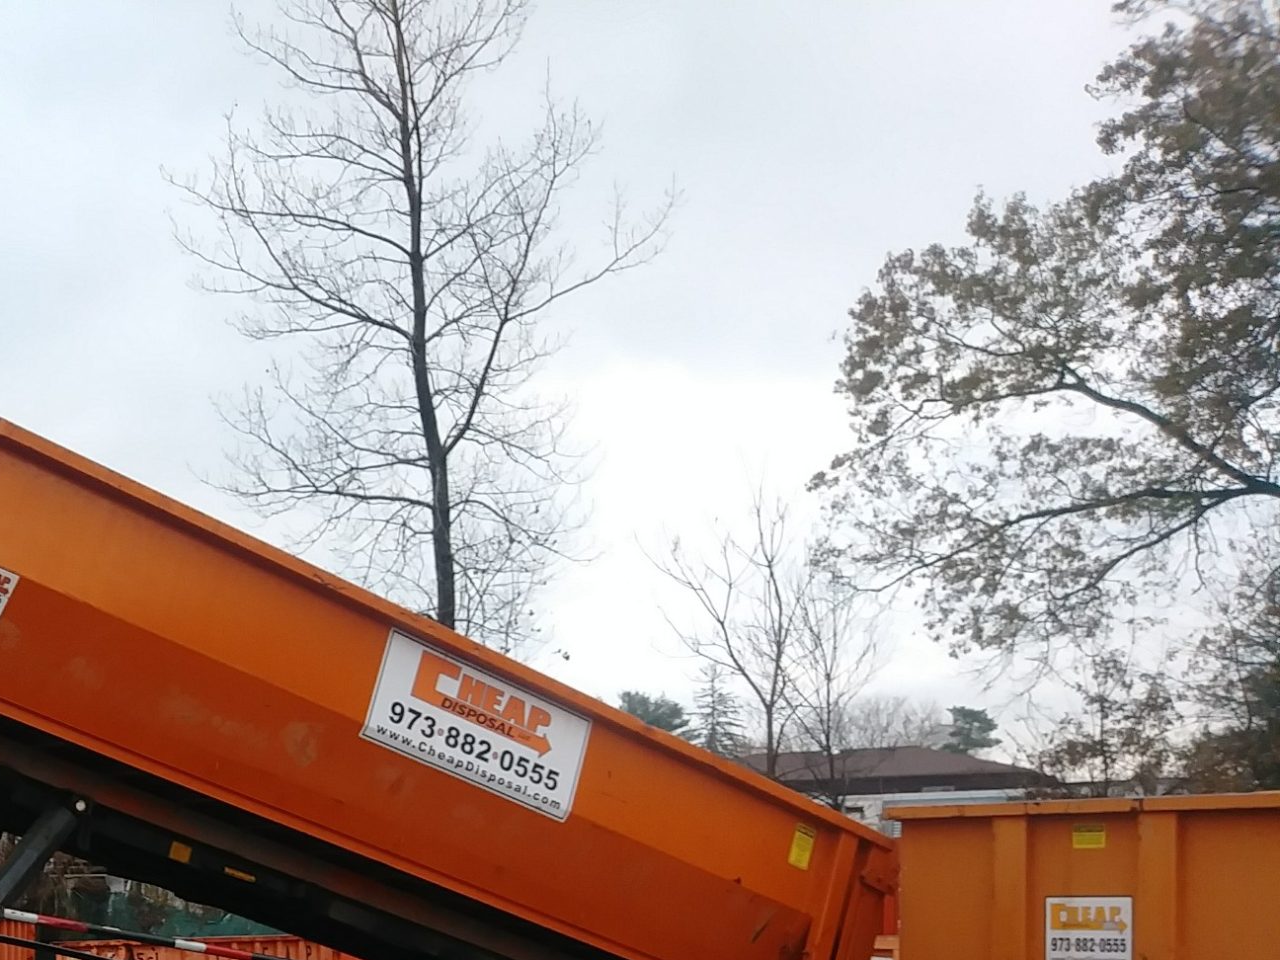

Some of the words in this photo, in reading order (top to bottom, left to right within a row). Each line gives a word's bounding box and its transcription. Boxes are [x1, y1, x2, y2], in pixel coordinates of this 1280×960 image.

[410, 649, 552, 737] CHEAP
[441, 697, 516, 739] DISPOSAL
[376, 724, 561, 810] www.CheapDisposal.com
[1050, 904, 1122, 930] CHEAP
[1051, 937, 1126, 953] 973-882-0555
